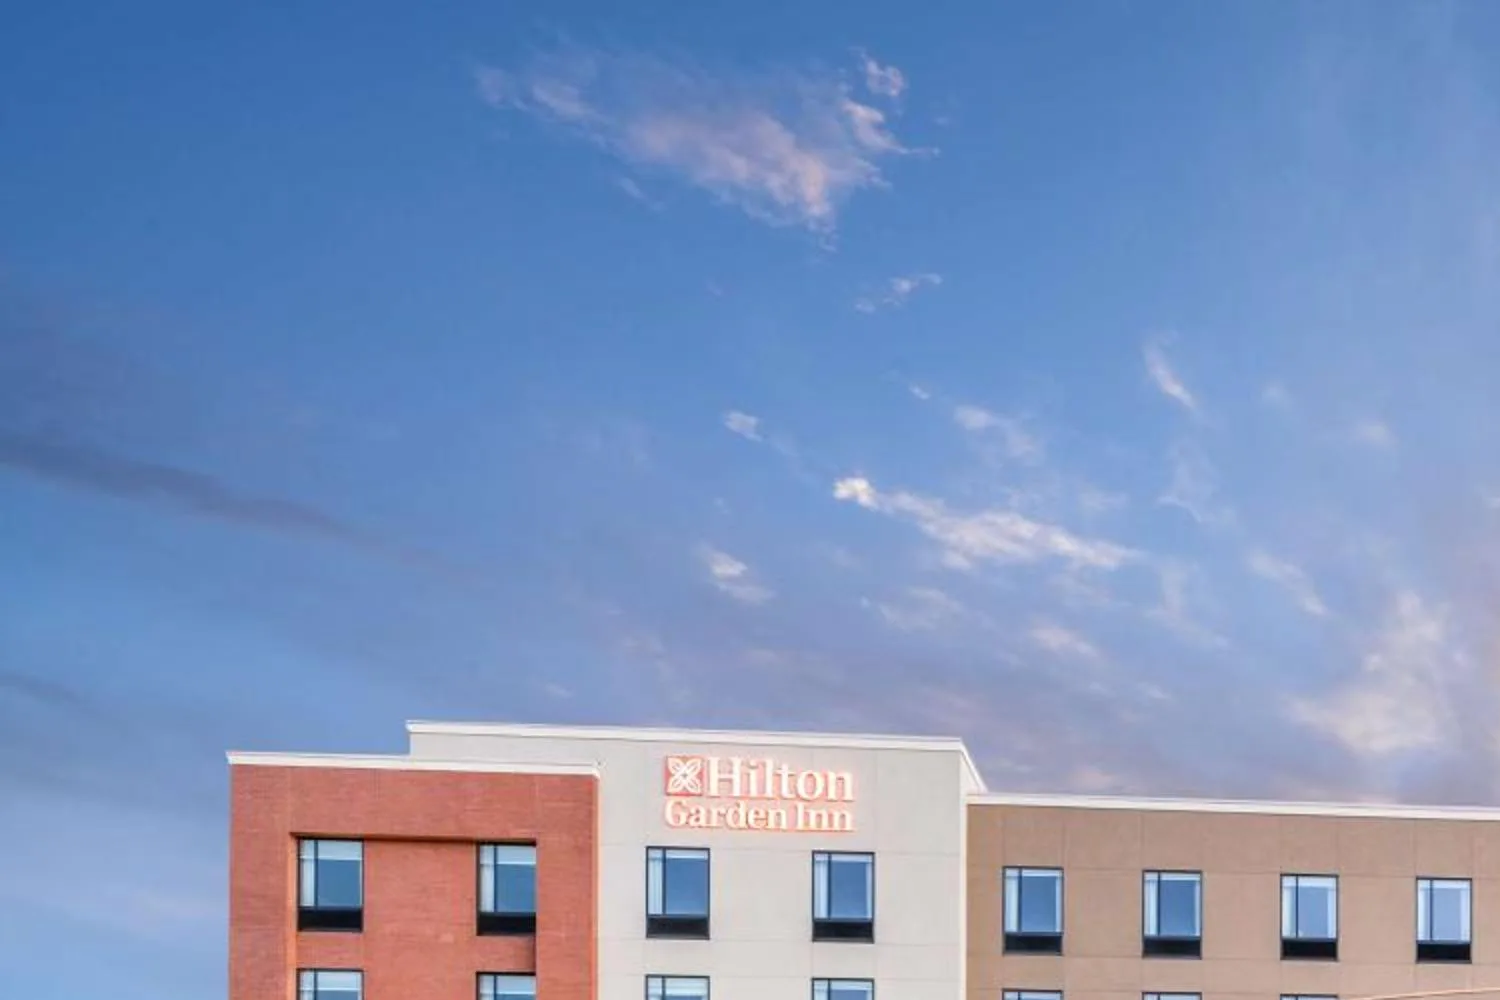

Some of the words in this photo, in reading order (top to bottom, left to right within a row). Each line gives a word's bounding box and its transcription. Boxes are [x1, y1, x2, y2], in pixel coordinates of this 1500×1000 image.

[707, 756, 854, 801] Hilton
[664, 799, 787, 829] Garden
[795, 801, 854, 832] Inn
